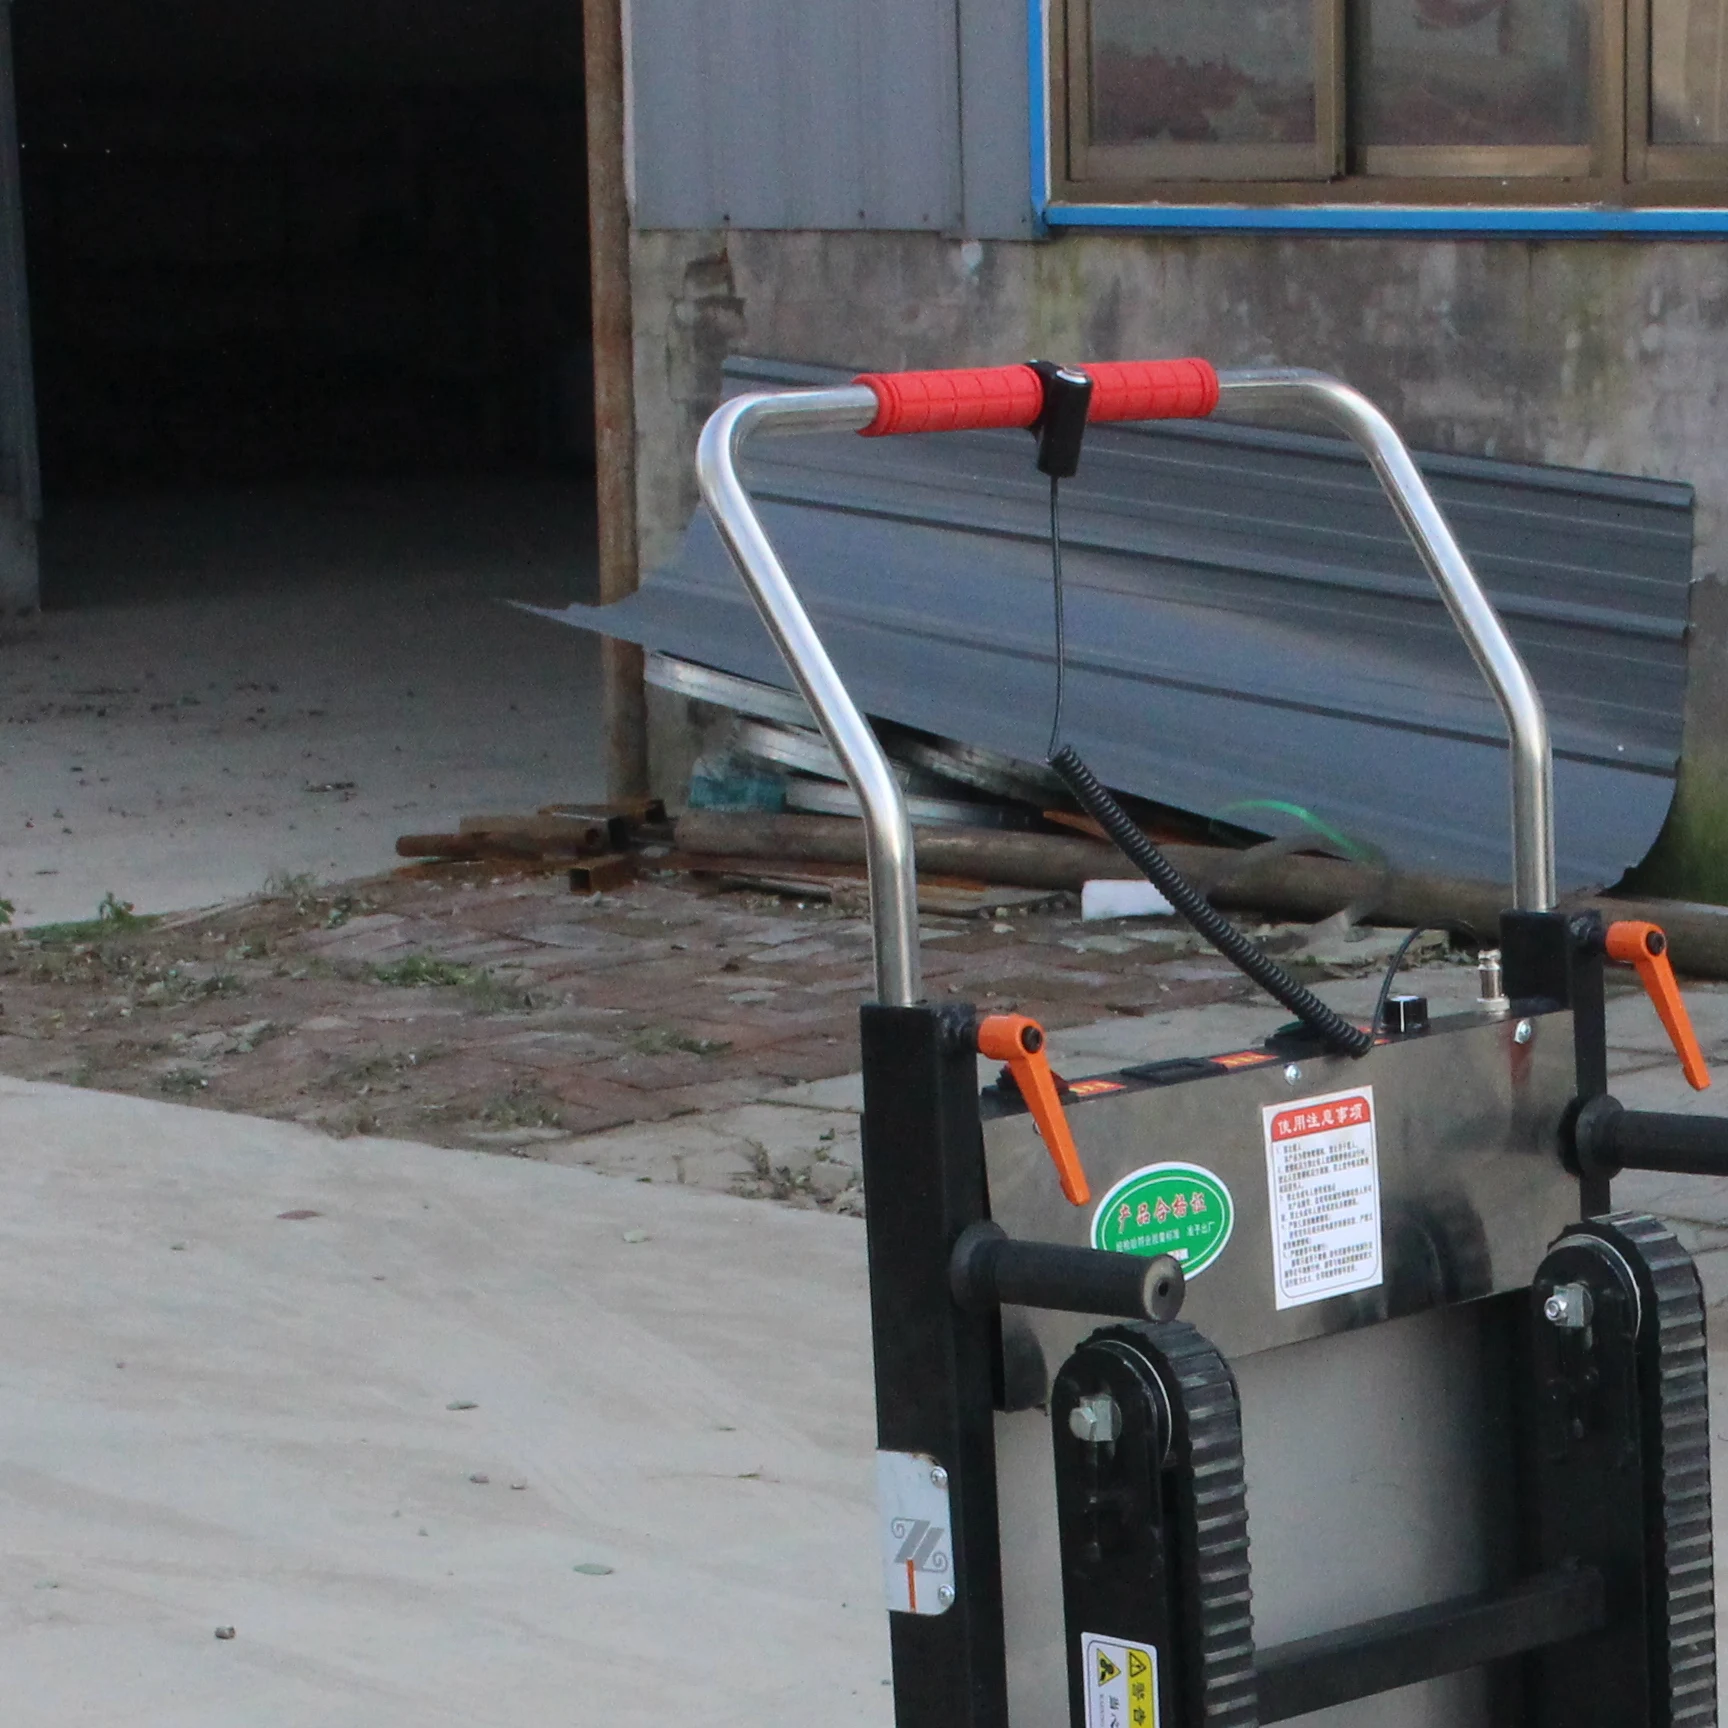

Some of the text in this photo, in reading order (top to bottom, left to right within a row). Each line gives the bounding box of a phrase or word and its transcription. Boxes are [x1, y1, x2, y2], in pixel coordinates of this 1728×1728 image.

[1278, 1103, 1363, 1134] 使用注意事项
[1118, 1191, 1207, 1234] 产品合格证
